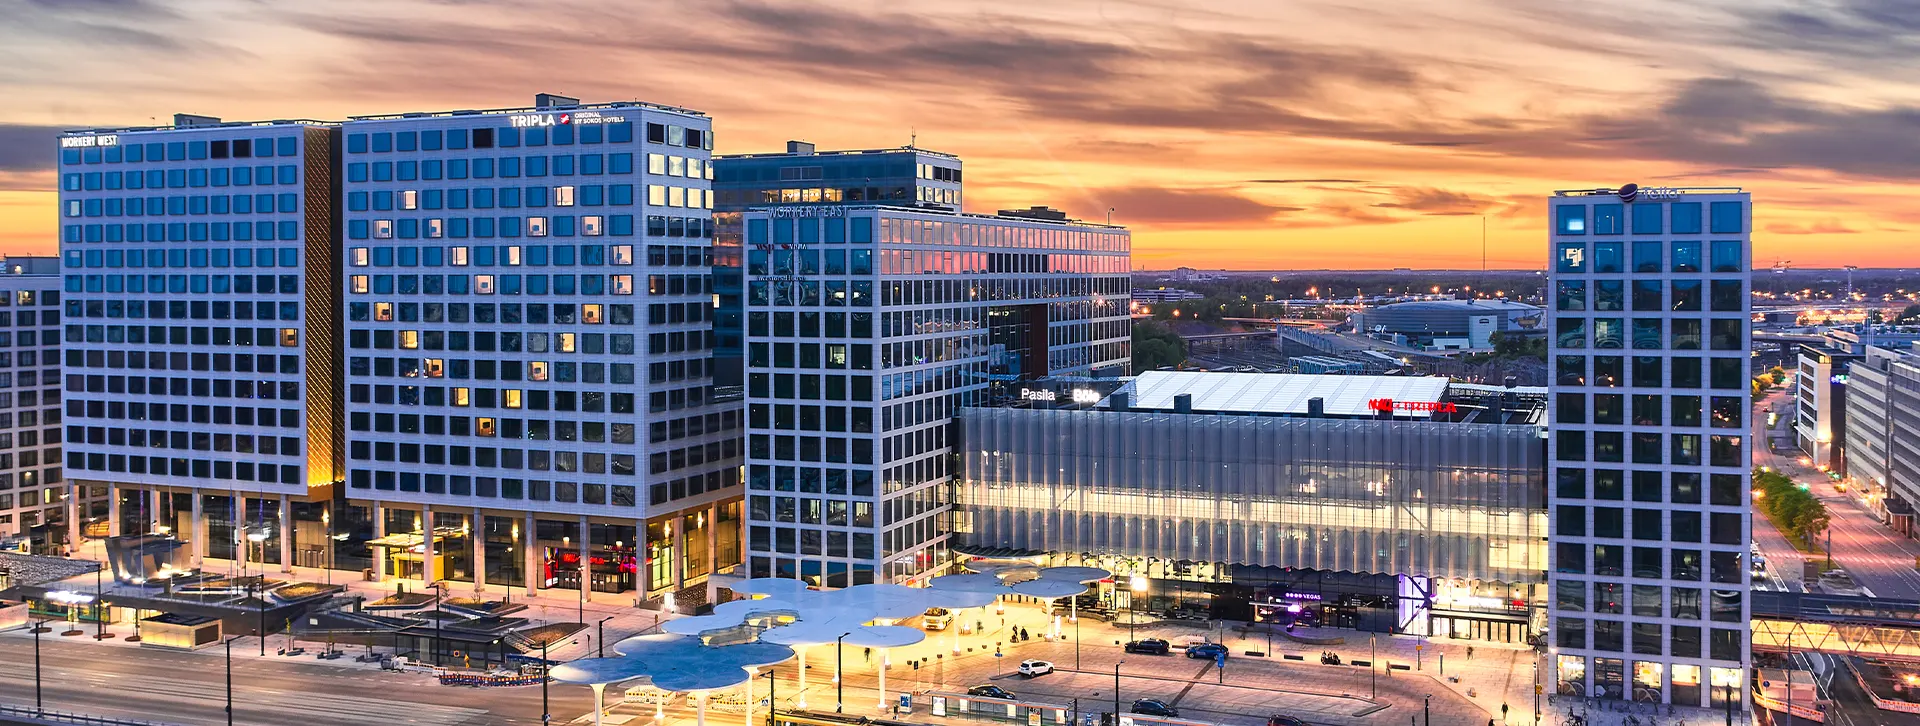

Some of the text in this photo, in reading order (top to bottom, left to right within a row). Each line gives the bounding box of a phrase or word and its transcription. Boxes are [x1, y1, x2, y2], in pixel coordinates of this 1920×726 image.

[510, 114, 556, 127] TRIPLA
[61, 135, 117, 147] WORKERY WEST
[768, 205, 848, 218] WORKERY EAST
[1021, 388, 1056, 400] Pasila
